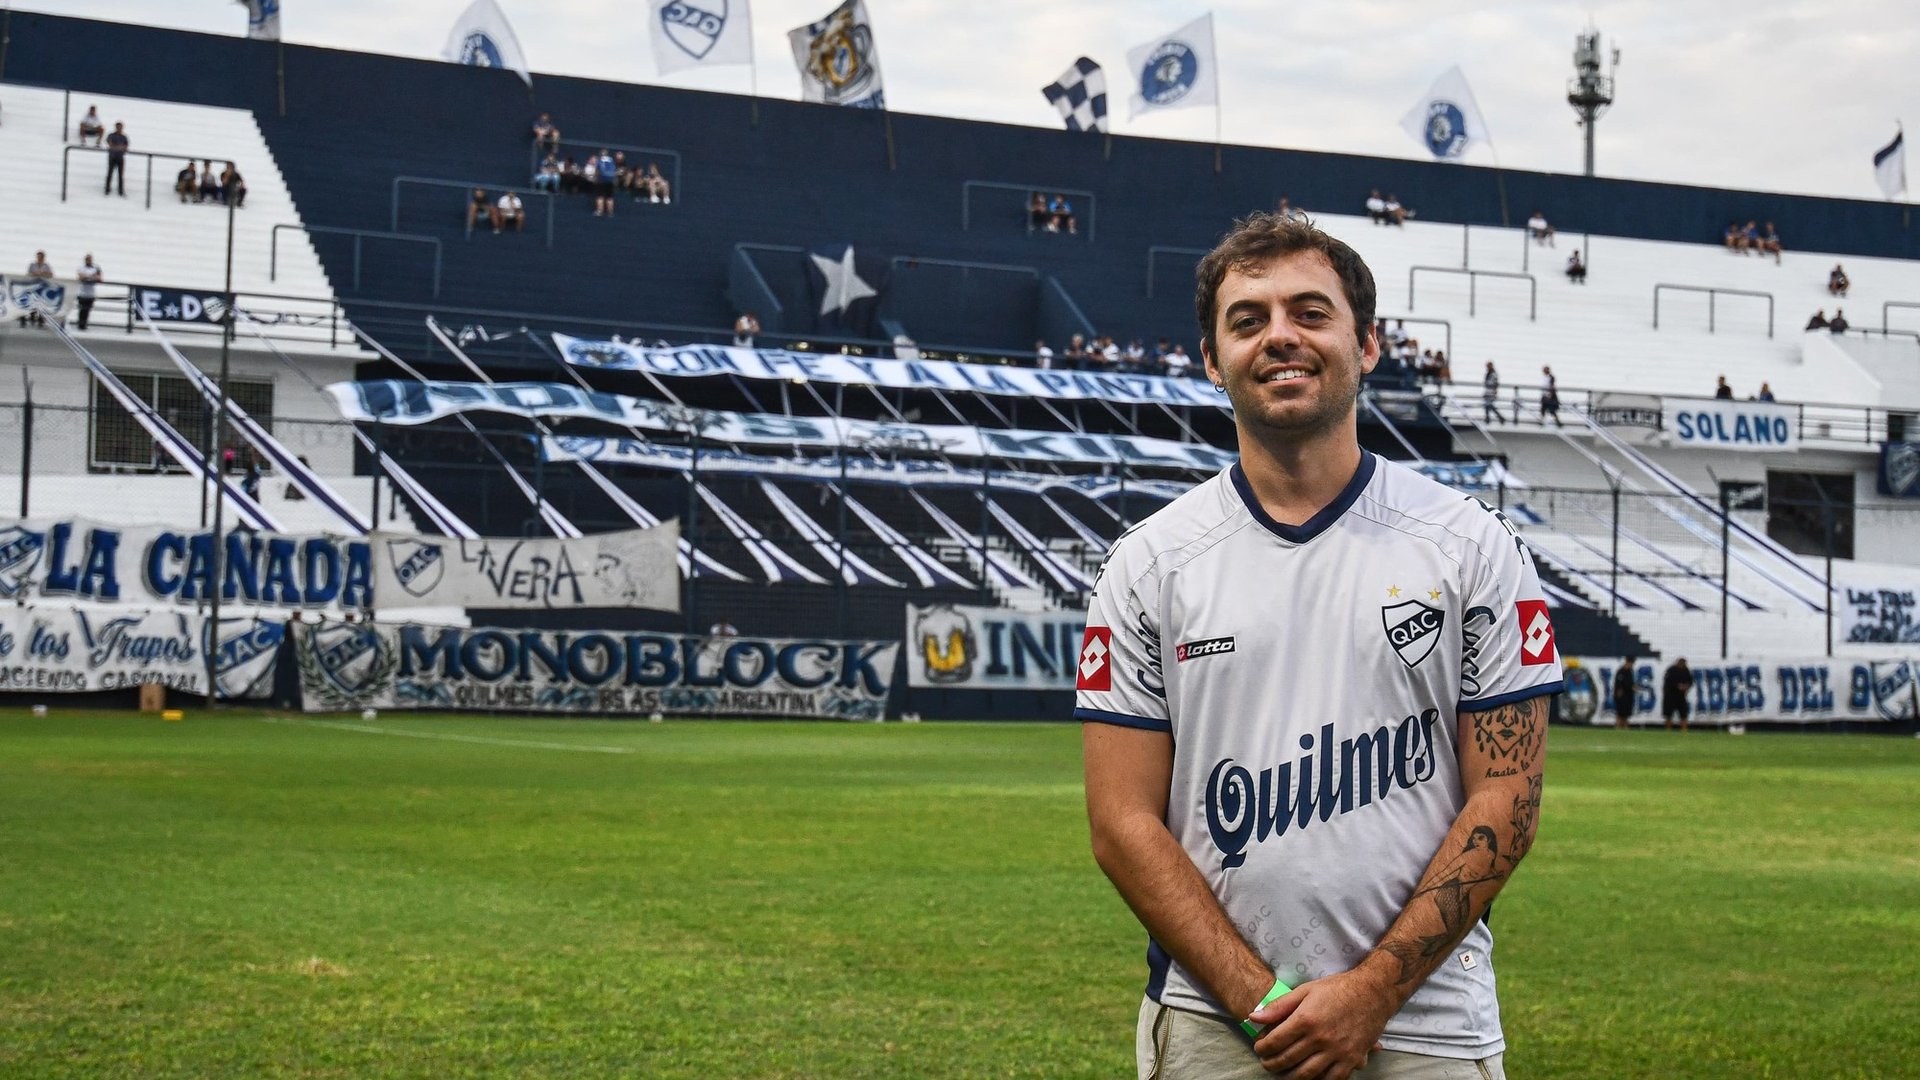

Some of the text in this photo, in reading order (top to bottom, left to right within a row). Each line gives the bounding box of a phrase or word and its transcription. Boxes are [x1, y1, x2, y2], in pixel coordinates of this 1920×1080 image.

[643, 349, 741, 373] CON
[754, 350, 832, 379] FE
[846, 357, 880, 382] Y
[904, 361, 946, 386] A
[1676, 411, 1789, 443] SOLANO
[45, 523, 120, 598] LA
[400, 545, 440, 584] QAC
[487, 541, 584, 608] VERA
[1187, 640, 1234, 655] lotto
[1391, 611, 1438, 645] QAC
[397, 625, 890, 697] MONOBLOCK
[720, 690, 817, 713] ARGENTINA
[1600, 666, 1656, 710] LS
[1690, 665, 1764, 711] IBES
[1778, 667, 1833, 711] DEL
[1205, 708, 1439, 872] Quilmes
